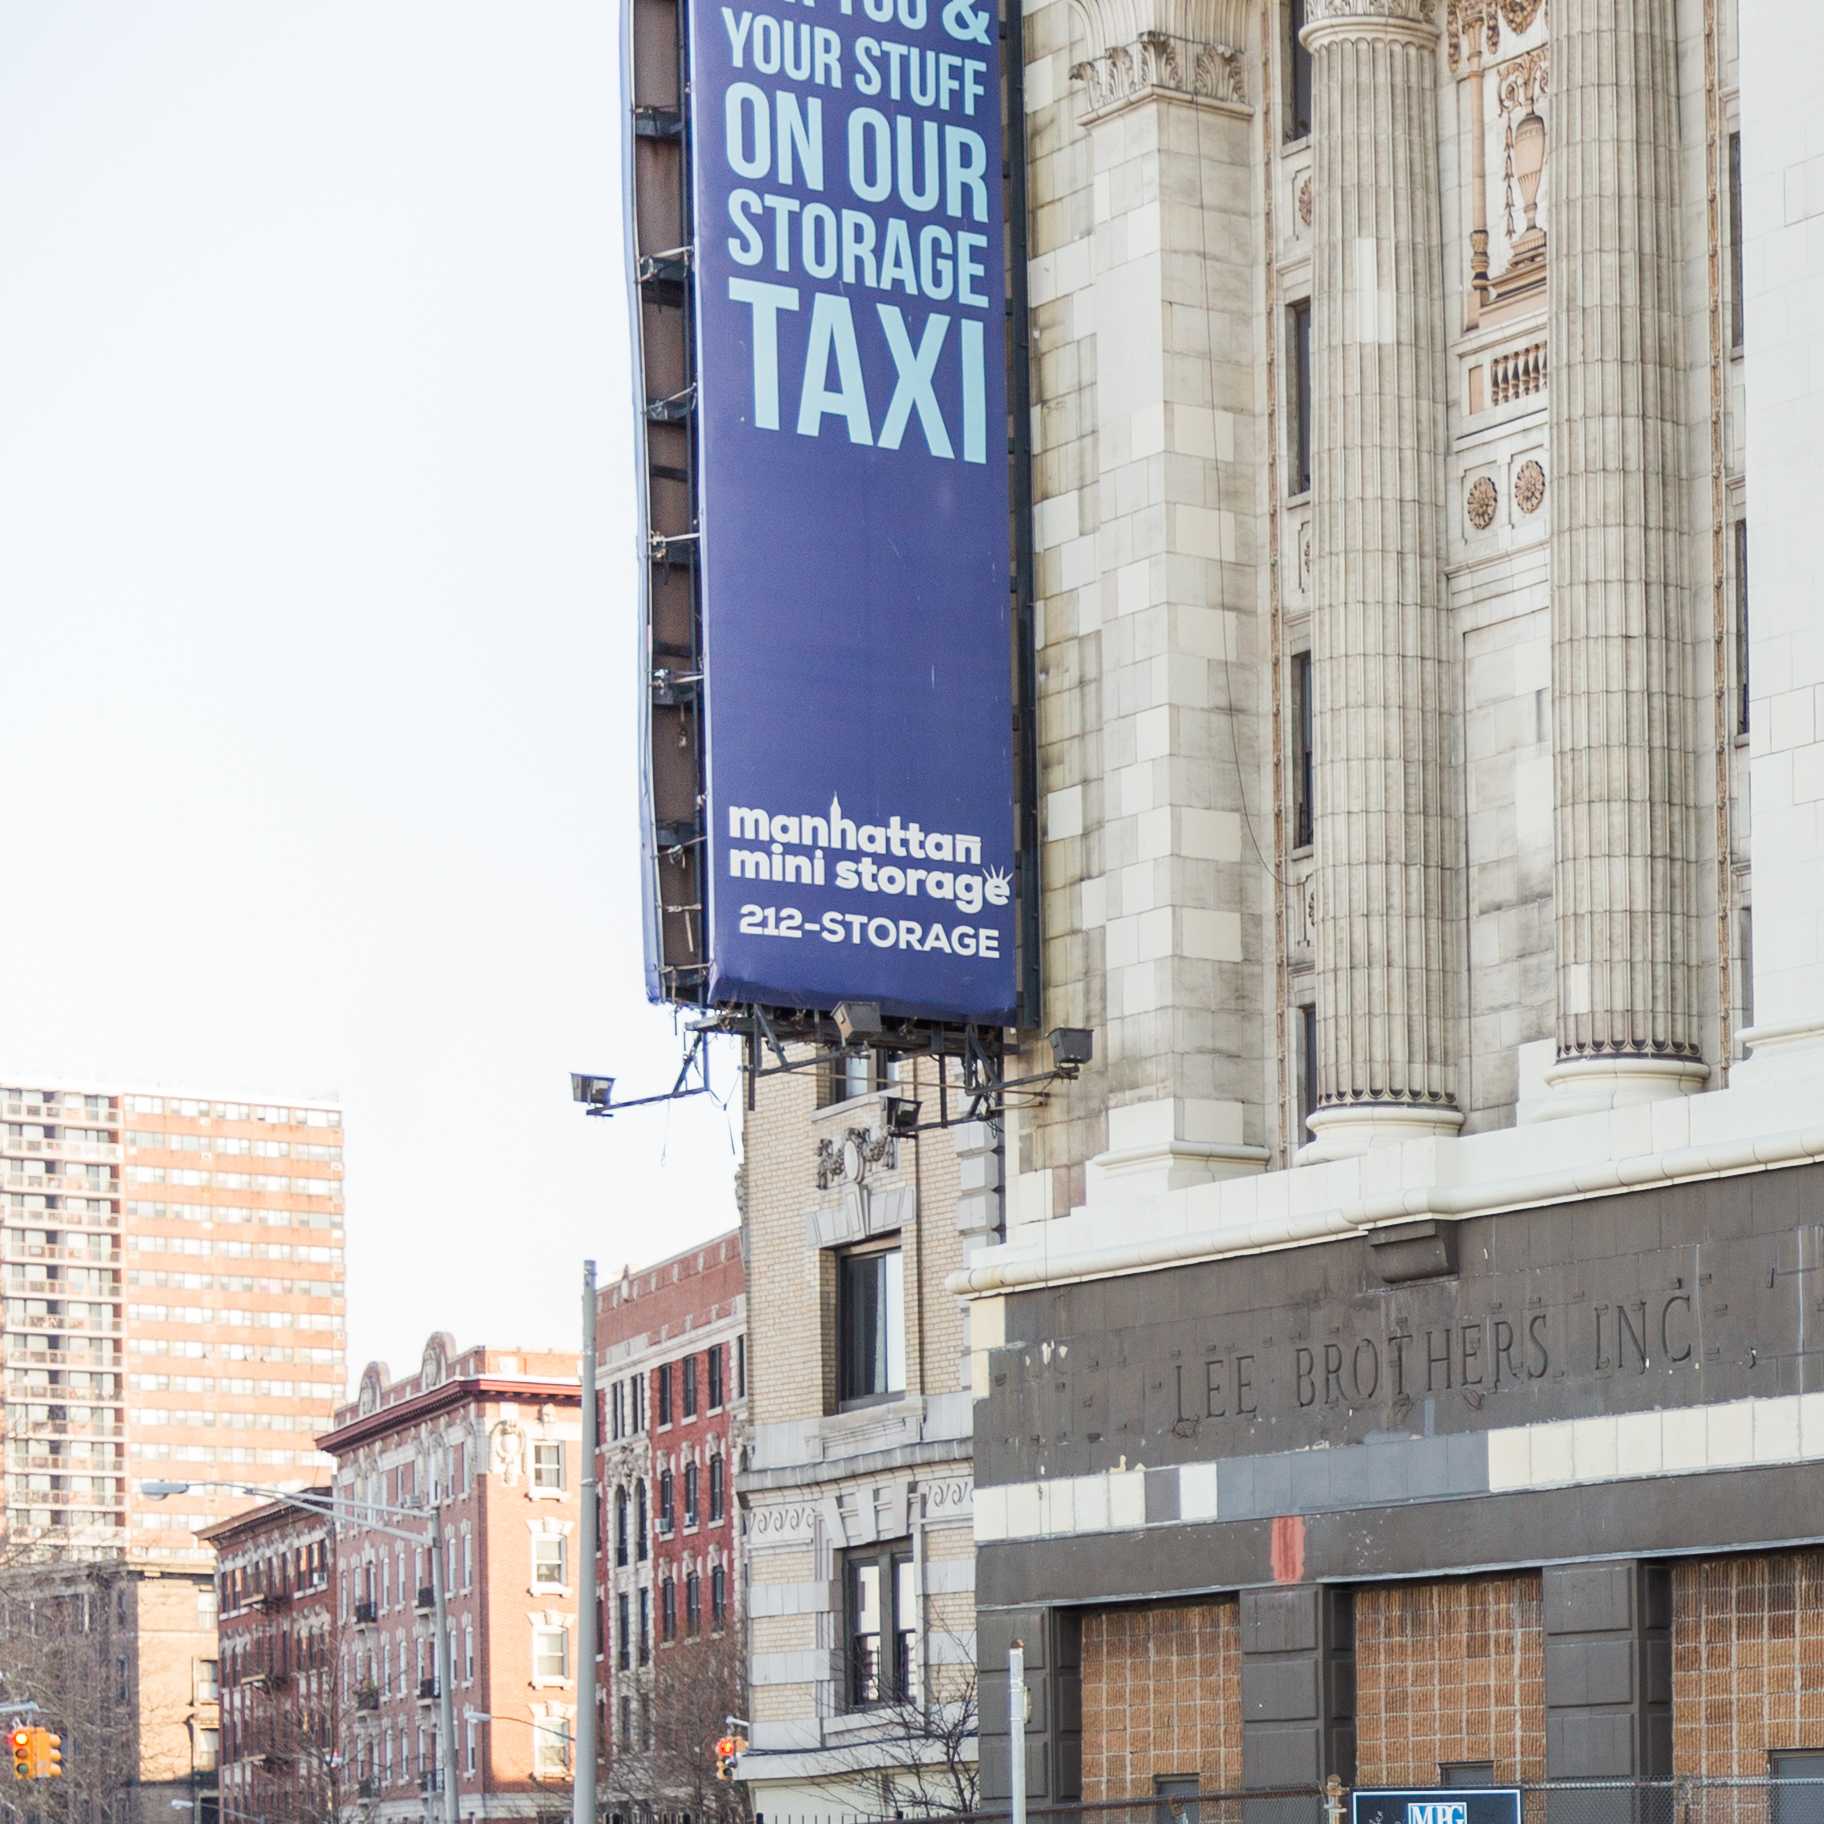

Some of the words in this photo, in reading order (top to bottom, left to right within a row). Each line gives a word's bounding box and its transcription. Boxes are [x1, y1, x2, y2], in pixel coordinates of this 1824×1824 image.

[721, 6, 842, 89] YOUR
[854, 36, 988, 116] STUFF
[724, 82, 824, 192] ON
[847, 107, 989, 224] OUR
[727, 188, 990, 309] STORAGE
[728, 276, 988, 465] TAXI
[729, 791, 982, 865] manhattan
[729, 843, 826, 886] mini
[835, 856, 1014, 914] storage
[739, 904, 1001, 959] 212-STORAGE
[1175, 1354, 1258, 1423] LEE
[1295, 1314, 1549, 1408] BROTHERS
[1595, 1295, 1692, 1374] INC
